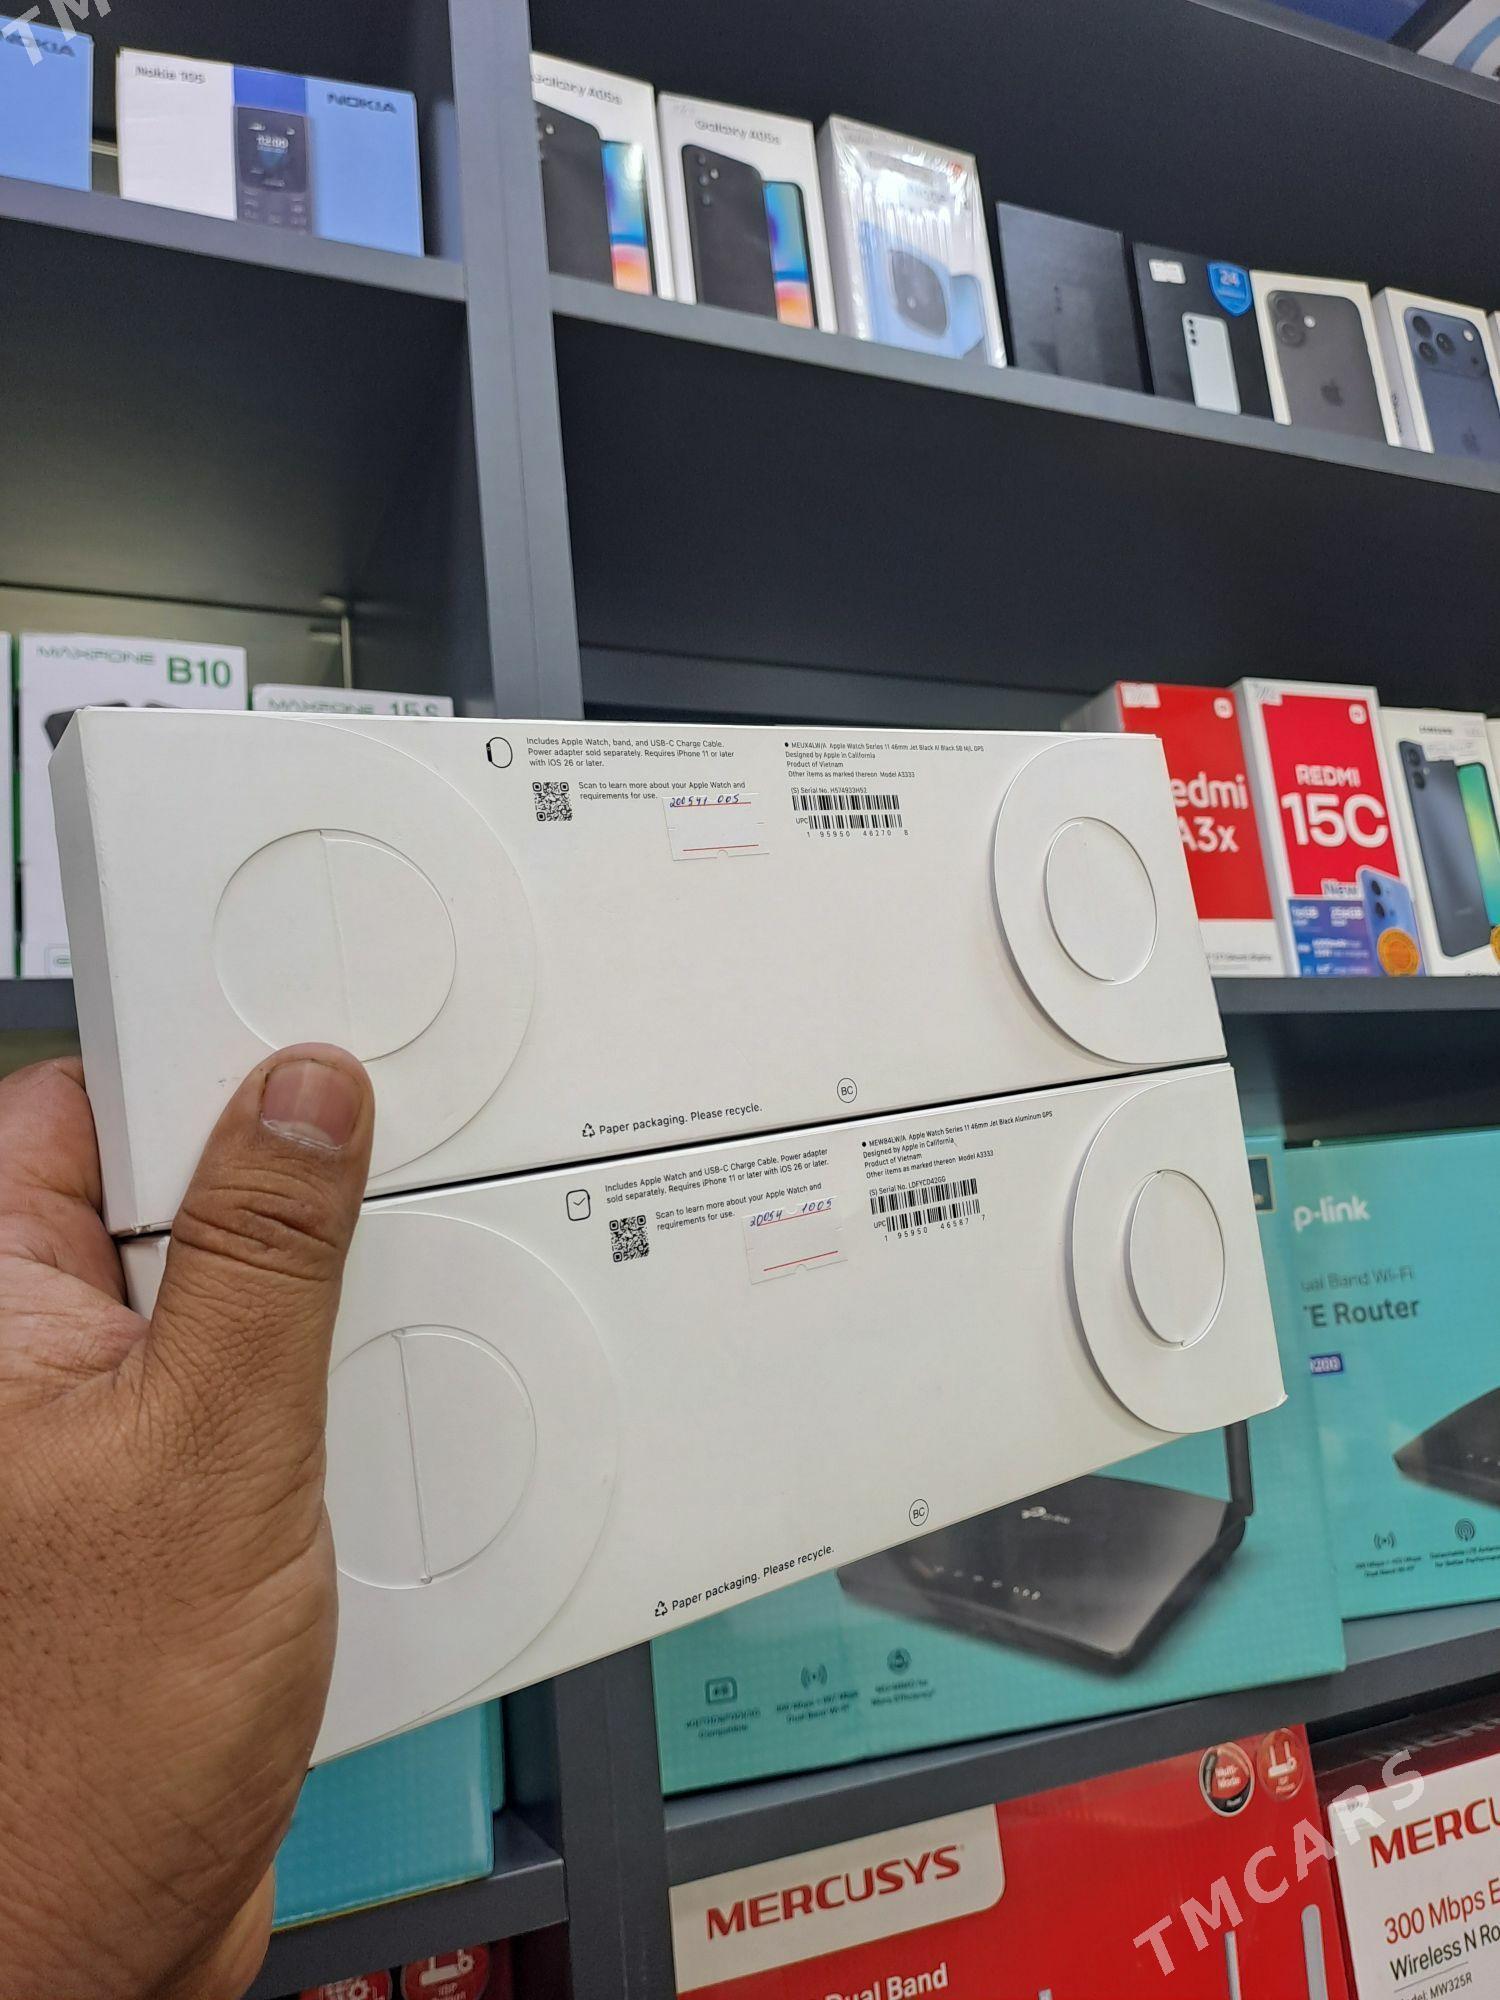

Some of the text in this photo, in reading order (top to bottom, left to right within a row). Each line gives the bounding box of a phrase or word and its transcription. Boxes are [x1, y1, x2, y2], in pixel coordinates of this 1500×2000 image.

[327, 93, 397, 114] NOKIA
[167, 657, 232, 687] B10
[554, 749, 583, 758] adapter
[603, 749, 643, 758] separately.
[645, 750, 675, 758] Requires
[562, 738, 583, 747] Apple
[585, 739, 610, 747] Watch,
[613, 739, 633, 748] band,
[636, 739, 648, 747] and
[676, 740, 701, 749] Charge
[585, 759, 604, 767] later.
[1297, 765, 1360, 787] REDMI
[578, 781, 597, 789] Scan
[609, 781, 627, 789] learn
[649, 781, 669, 789] about
[672, 783, 686, 791] your
[689, 782, 708, 790] Apple
[710, 781, 731, 789] Watch
[733, 781, 745, 789] and
[580, 792, 629, 801] requirements
[630, 792, 641, 800] for
[1170, 771, 1248, 809] edmi
[1282, 792, 1389, 848] 15C
[841, 1085, 853, 1096] BC
[599, 1102, 762, 1135] Paper packaging. Please recycle.
[909, 1113, 1041, 1141] Apple Watch Series 46mm Black Aluminum
[863, 1137, 954, 1159] Designed Apple California
[865, 1152, 922, 1168] Product Vietnam
[605, 1148, 828, 1192] Includes Apple Watch and USB-C Charge Cable. Power adapter
[866, 1150, 994, 1179] Other items marked thereon Model A3333
[607, 1158, 829, 1204] sold separately. Requires iPhone later with later.
[879, 1184, 896, 1195] Serial
[656, 1182, 822, 1220] Scan learn more about your Apple Watch and
[1293, 1195, 1370, 1232] p-link
[657, 1211, 736, 1231] requirements use.
[898, 1227, 928, 1239] 95950
[1301, 1265, 1415, 1292] ual Band Wi-Fi
[1334, 1299, 1419, 1324] Router
[913, 1507, 925, 1519] BC
[672, 1545, 834, 1611] Paper packaging. Please recycle.
[706, 1845, 961, 1941] MERCUSYS
[1384, 1888, 1485, 1944] 300 Mbps
[1390, 1939, 1462, 1981] Wireless
[1464, 1930, 1477, 1950] N
[886, 1962, 948, 2000] Band
[1430, 1972, 1472, 2000] MW325R
